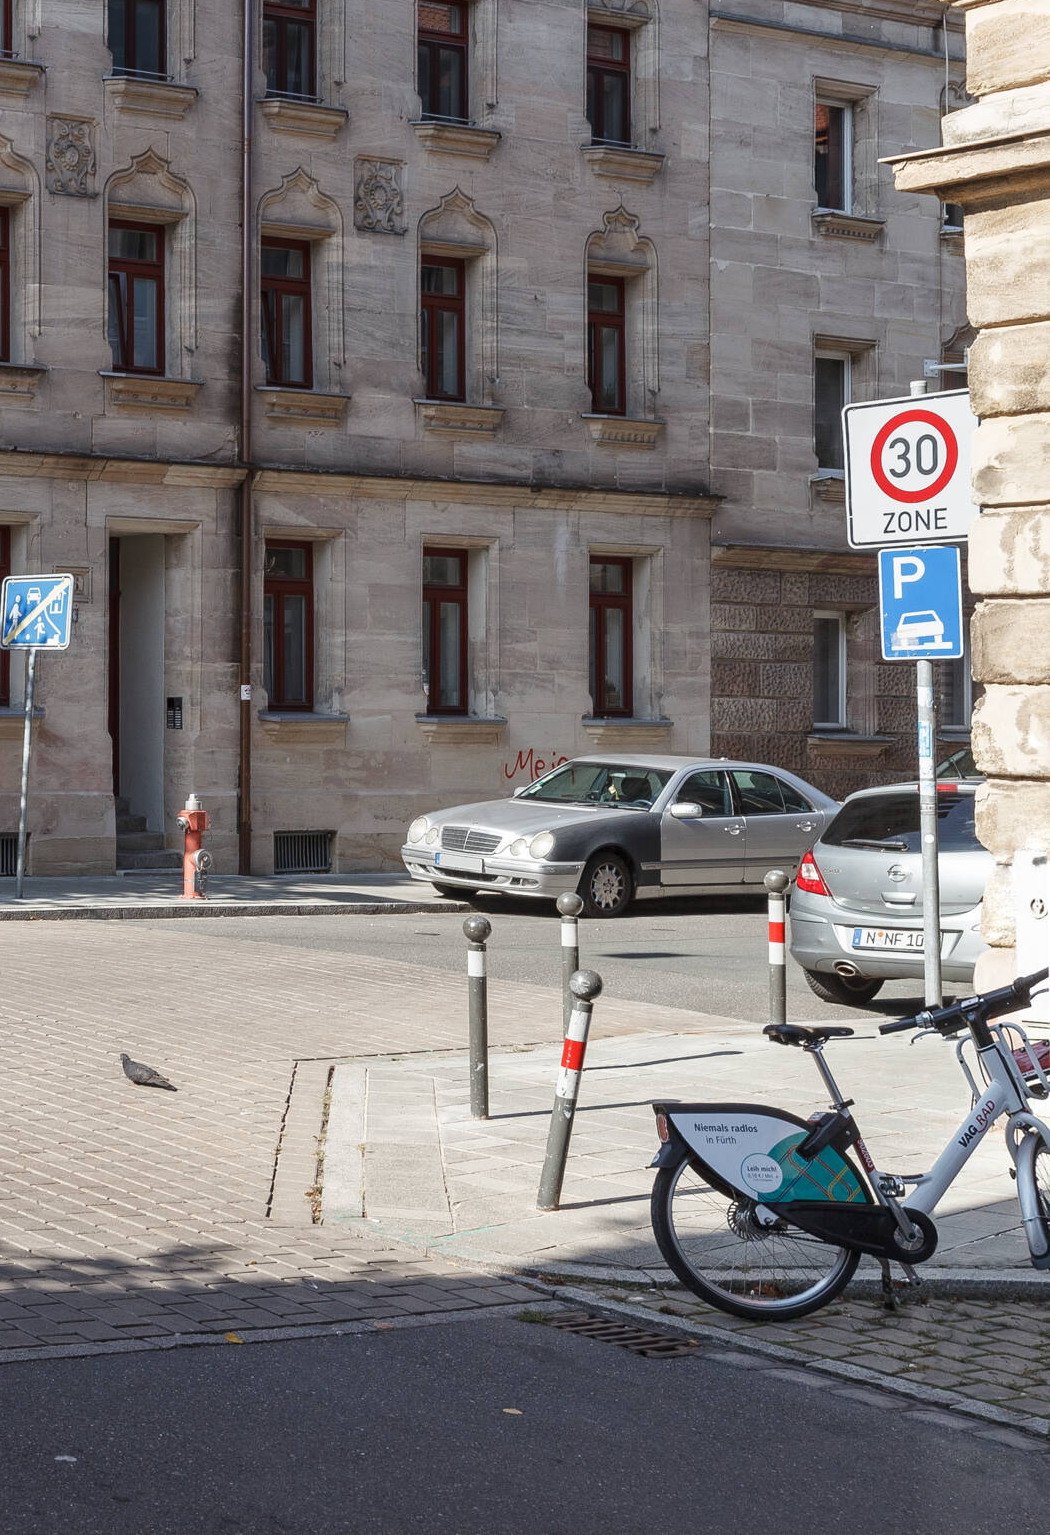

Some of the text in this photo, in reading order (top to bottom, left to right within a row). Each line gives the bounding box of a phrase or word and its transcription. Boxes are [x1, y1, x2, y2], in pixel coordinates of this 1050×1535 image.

[889, 434, 938, 478] 30
[883, 507, 948, 534] ZONE
[893, 555, 926, 599] P
[866, 931, 876, 945] N
[884, 932, 904, 946] NF
[694, 1123, 758, 1133] Niemals radlos
[958, 1100, 996, 1148] VAG RAD
[706, 1135, 737, 1144] in Fürth
